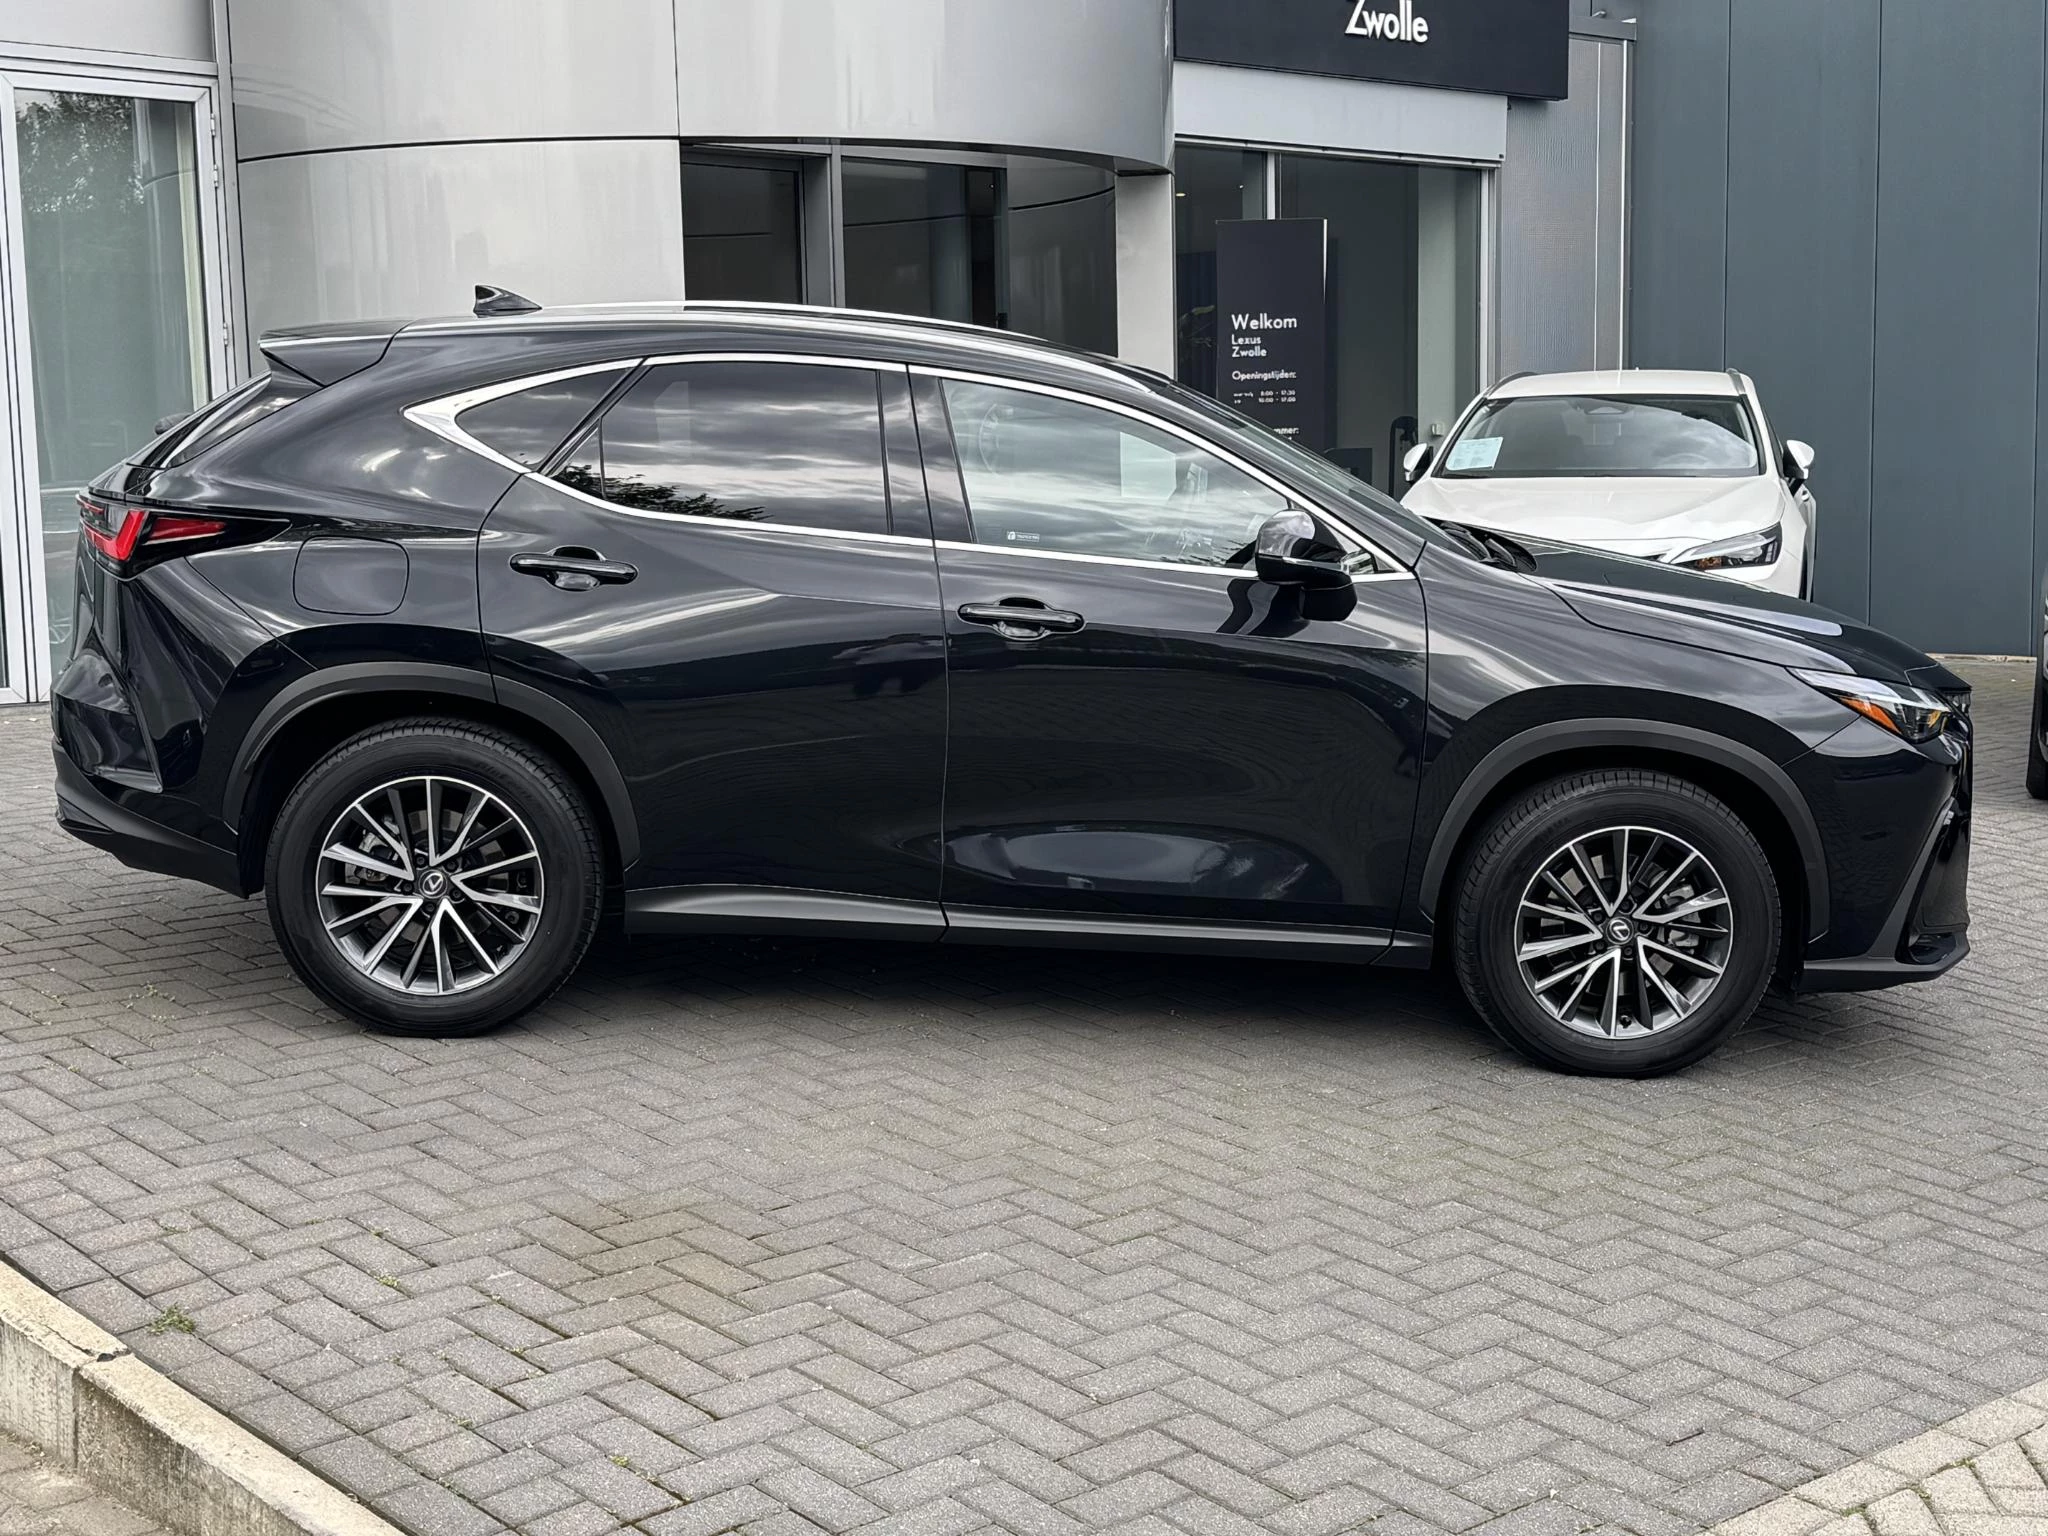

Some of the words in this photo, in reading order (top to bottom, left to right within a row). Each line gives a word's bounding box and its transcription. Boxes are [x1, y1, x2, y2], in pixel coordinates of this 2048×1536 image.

[1345, 0, 1429, 43] Zwolle
[1231, 313, 1297, 330] Welkom
[1231, 334, 1261, 345] Lexus
[1231, 345, 1267, 357] Zwolle
